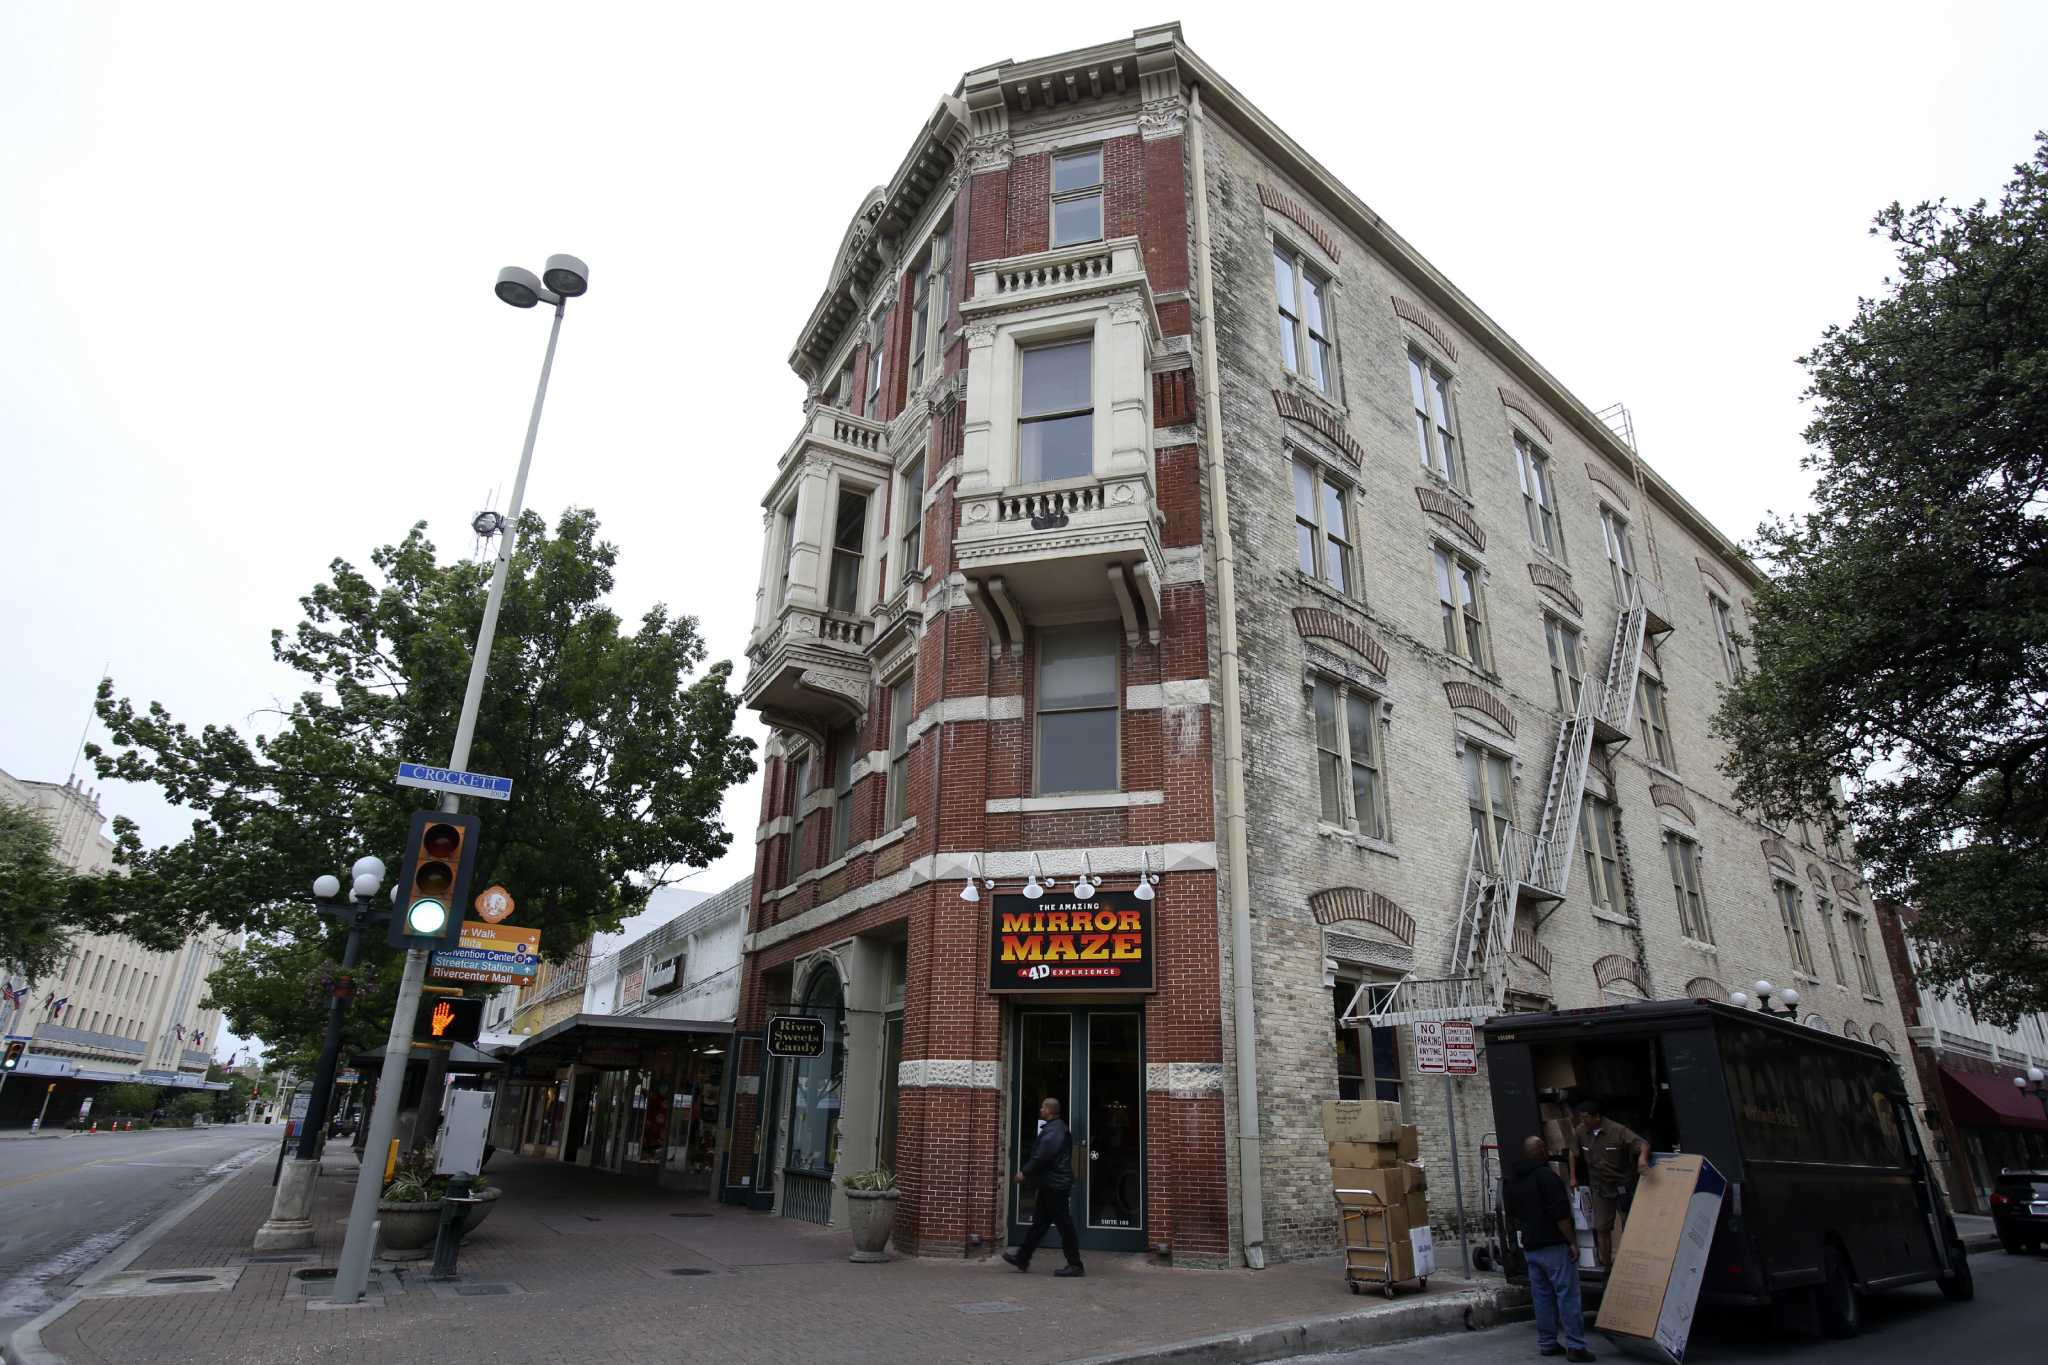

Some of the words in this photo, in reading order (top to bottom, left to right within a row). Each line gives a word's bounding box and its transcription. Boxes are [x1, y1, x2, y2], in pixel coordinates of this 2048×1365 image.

[412, 766, 498, 789] CROCKETT
[1058, 902, 1100, 911] AMAZING
[1001, 910, 1142, 933] MIRROR
[471, 928, 497, 940] Walk
[1000, 933, 1142, 962] MAZE
[487, 951, 515, 962] Center
[435, 956, 480, 968] Streetcar
[481, 961, 514, 973] Station
[433, 967, 490, 982] Rivercenter
[491, 973, 513, 984] Mall
[1028, 964, 1050, 980] 4D
[1052, 968, 1115, 976] EXPERIENCE
[780, 1020, 816, 1031] River
[1421, 1024, 1436, 1034] NO
[774, 1031, 819, 1042] Sweets
[1417, 1036, 1442, 1047] PARKING
[775, 1041, 817, 1054] Candy
[1419, 1047, 1442, 1056] ANYTIME
